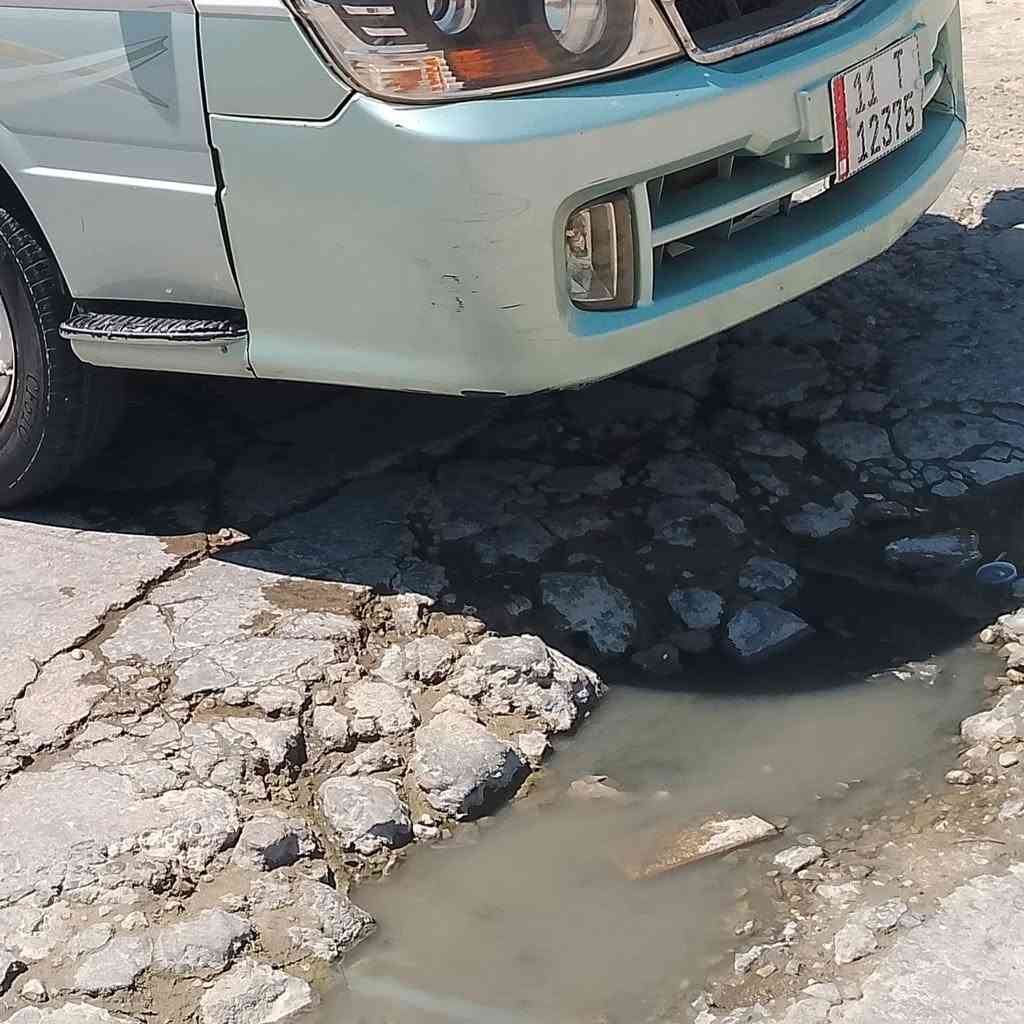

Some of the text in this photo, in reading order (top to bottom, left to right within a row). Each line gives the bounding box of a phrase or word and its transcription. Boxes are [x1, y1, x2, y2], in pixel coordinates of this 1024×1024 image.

[853, 48, 904, 114] 11 T
[856, 91, 916, 163] 12375
